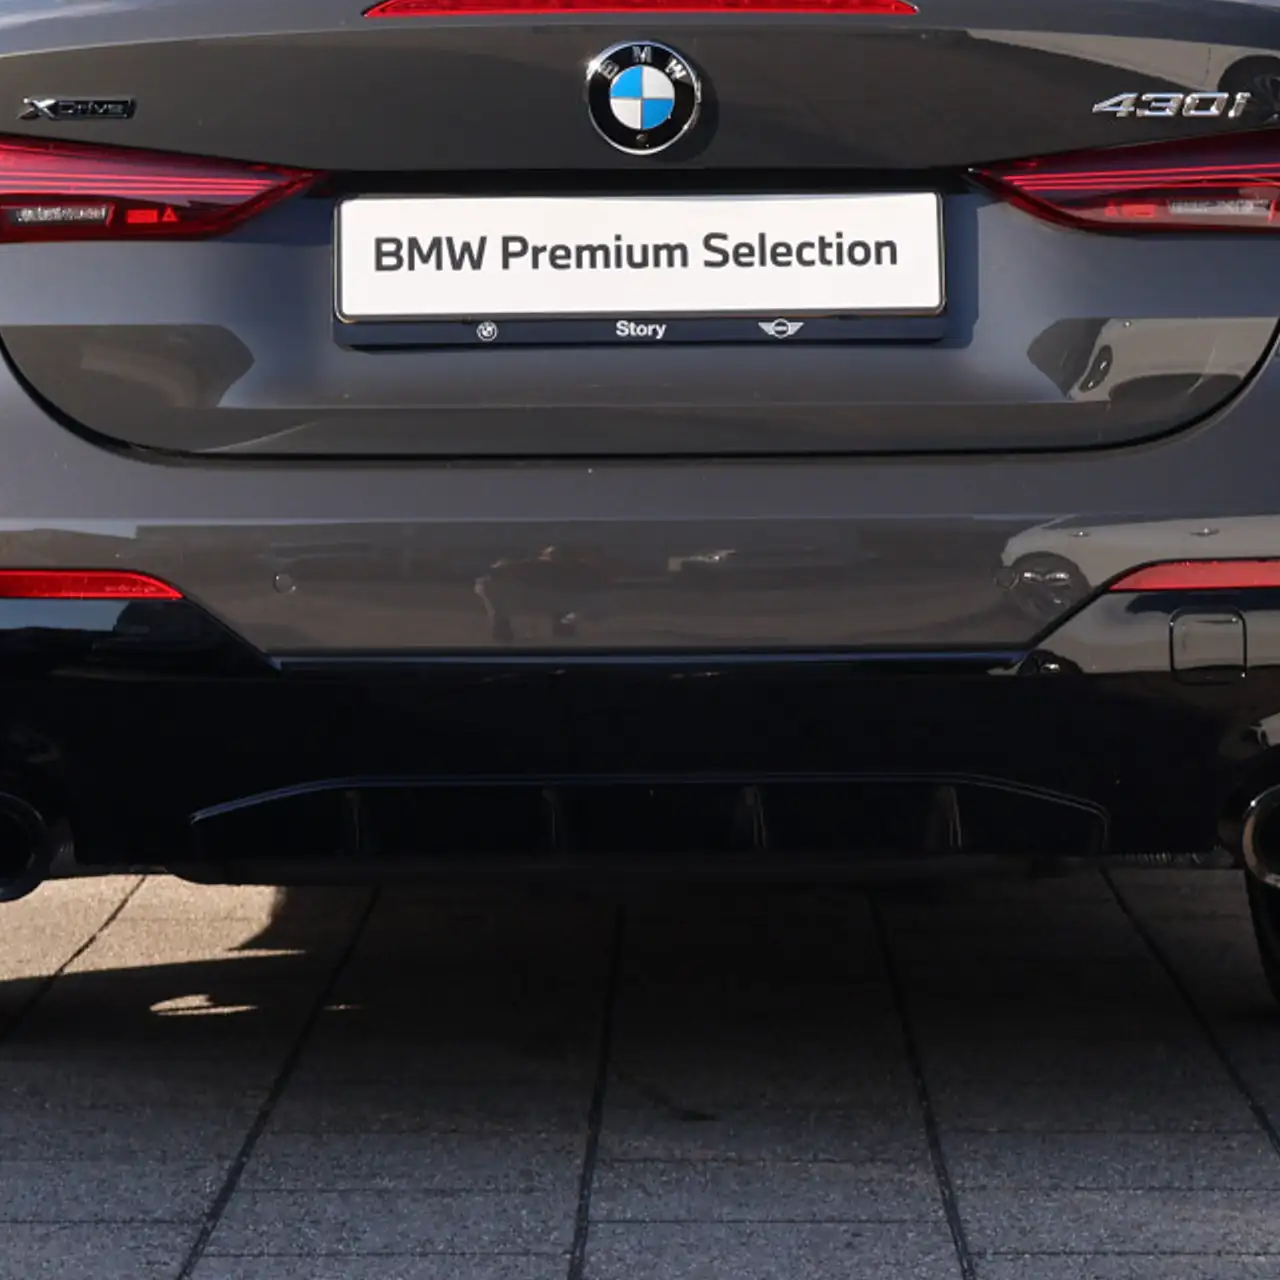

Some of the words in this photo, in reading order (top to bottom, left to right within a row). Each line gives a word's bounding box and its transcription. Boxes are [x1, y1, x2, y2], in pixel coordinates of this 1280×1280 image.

[1092, 91, 1251, 119] 430i
[374, 235, 488, 272] BMW
[501, 233, 689, 271] Premium
[702, 231, 899, 269] Selection
[615, 321, 667, 340] Story
